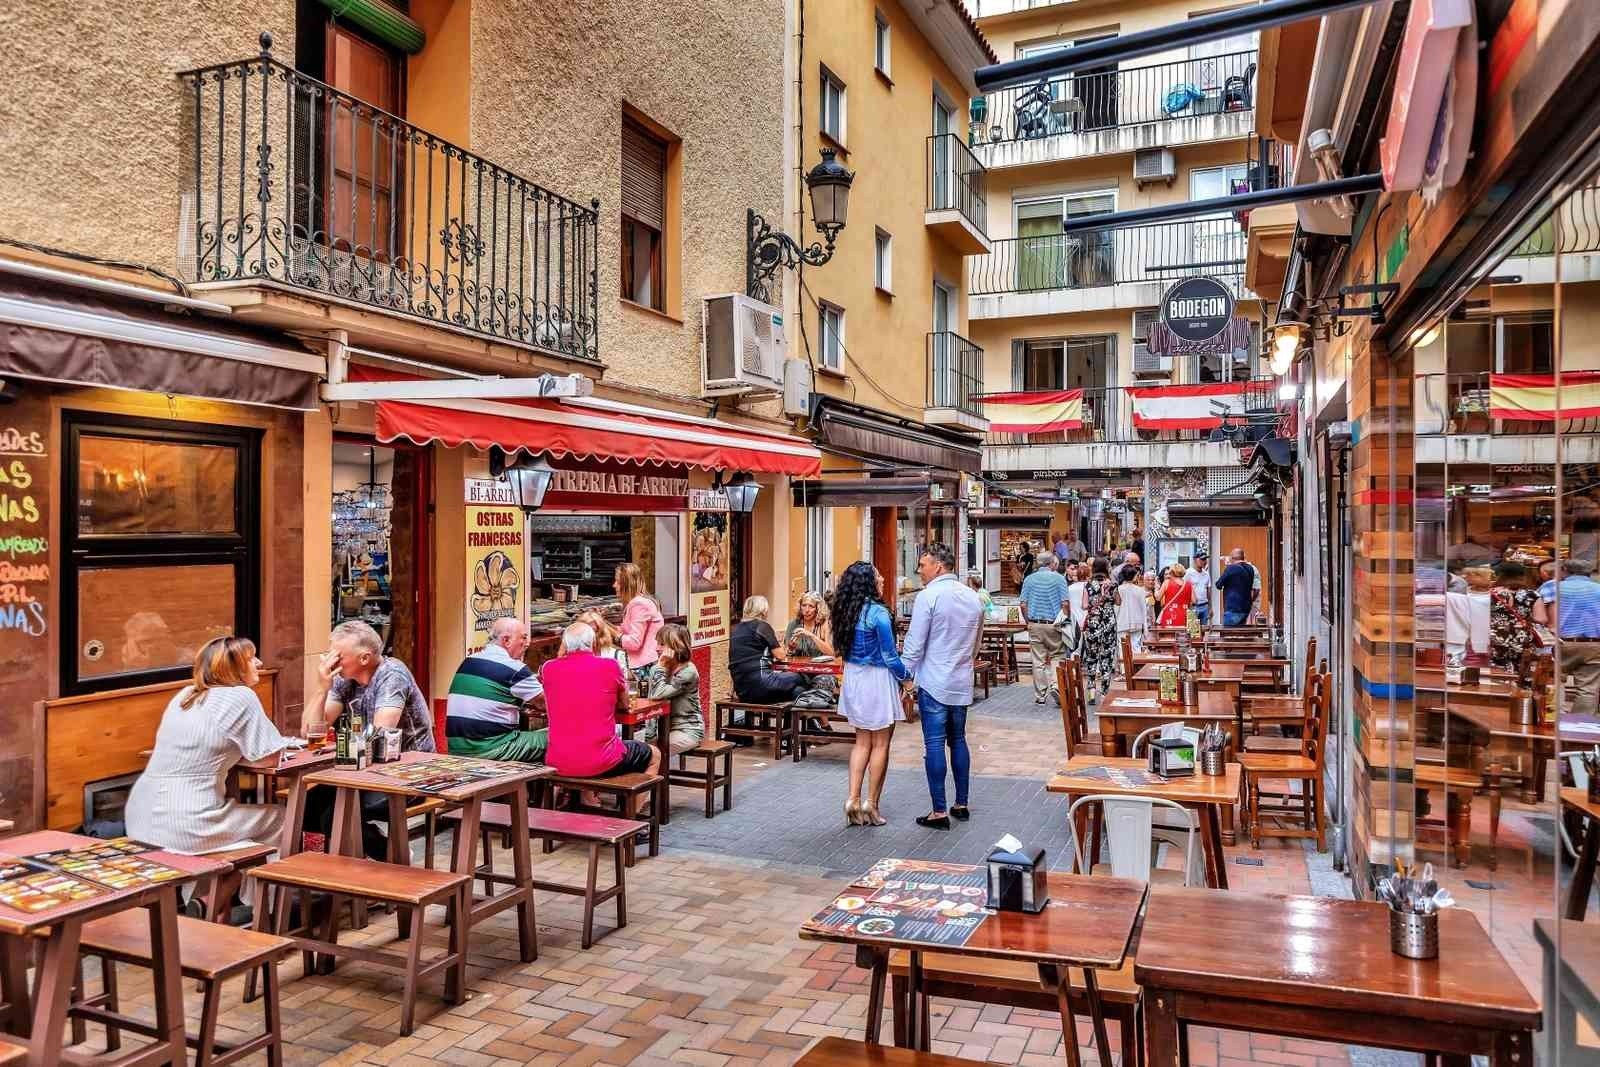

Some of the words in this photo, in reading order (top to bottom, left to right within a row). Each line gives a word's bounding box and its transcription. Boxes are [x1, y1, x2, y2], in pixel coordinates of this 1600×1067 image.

[1170, 297, 1225, 318] BODEGON
[470, 487, 513, 502] BI-ARRIT
[477, 511, 514, 527] OSTRAS
[468, 532, 521, 547] FRANCESAS
